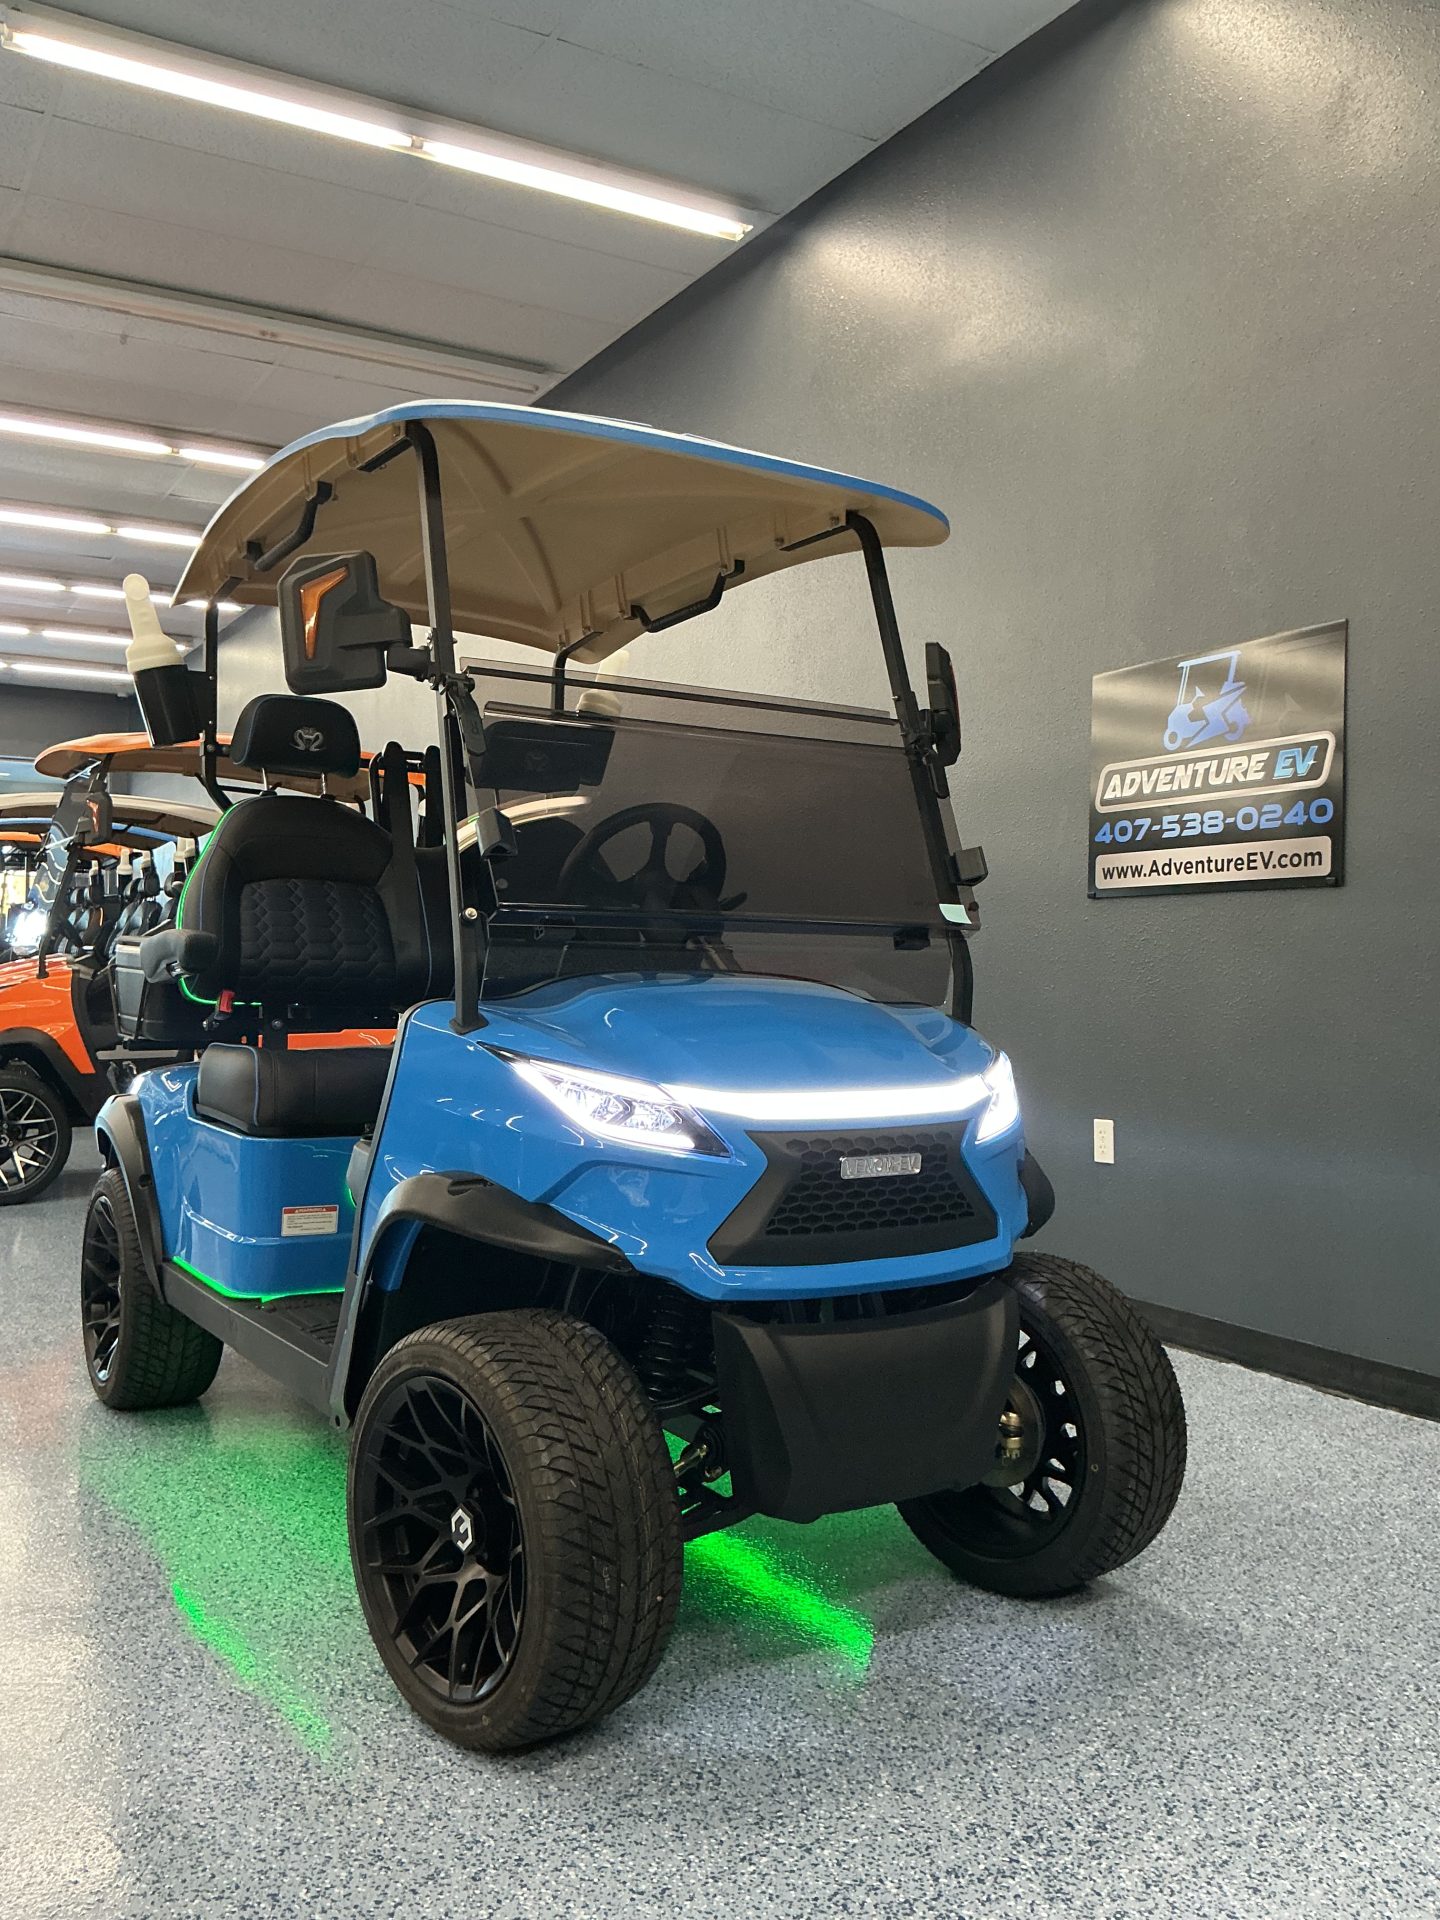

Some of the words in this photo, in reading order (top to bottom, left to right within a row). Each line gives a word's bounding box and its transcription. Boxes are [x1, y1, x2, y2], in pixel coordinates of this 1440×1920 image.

[1104, 752, 1270, 800] ADVENTURE
[1273, 746, 1319, 780] EV
[1095, 798, 1334, 844] 407-538-0240
[1103, 851, 1322, 880] www.AdventureEV.com
